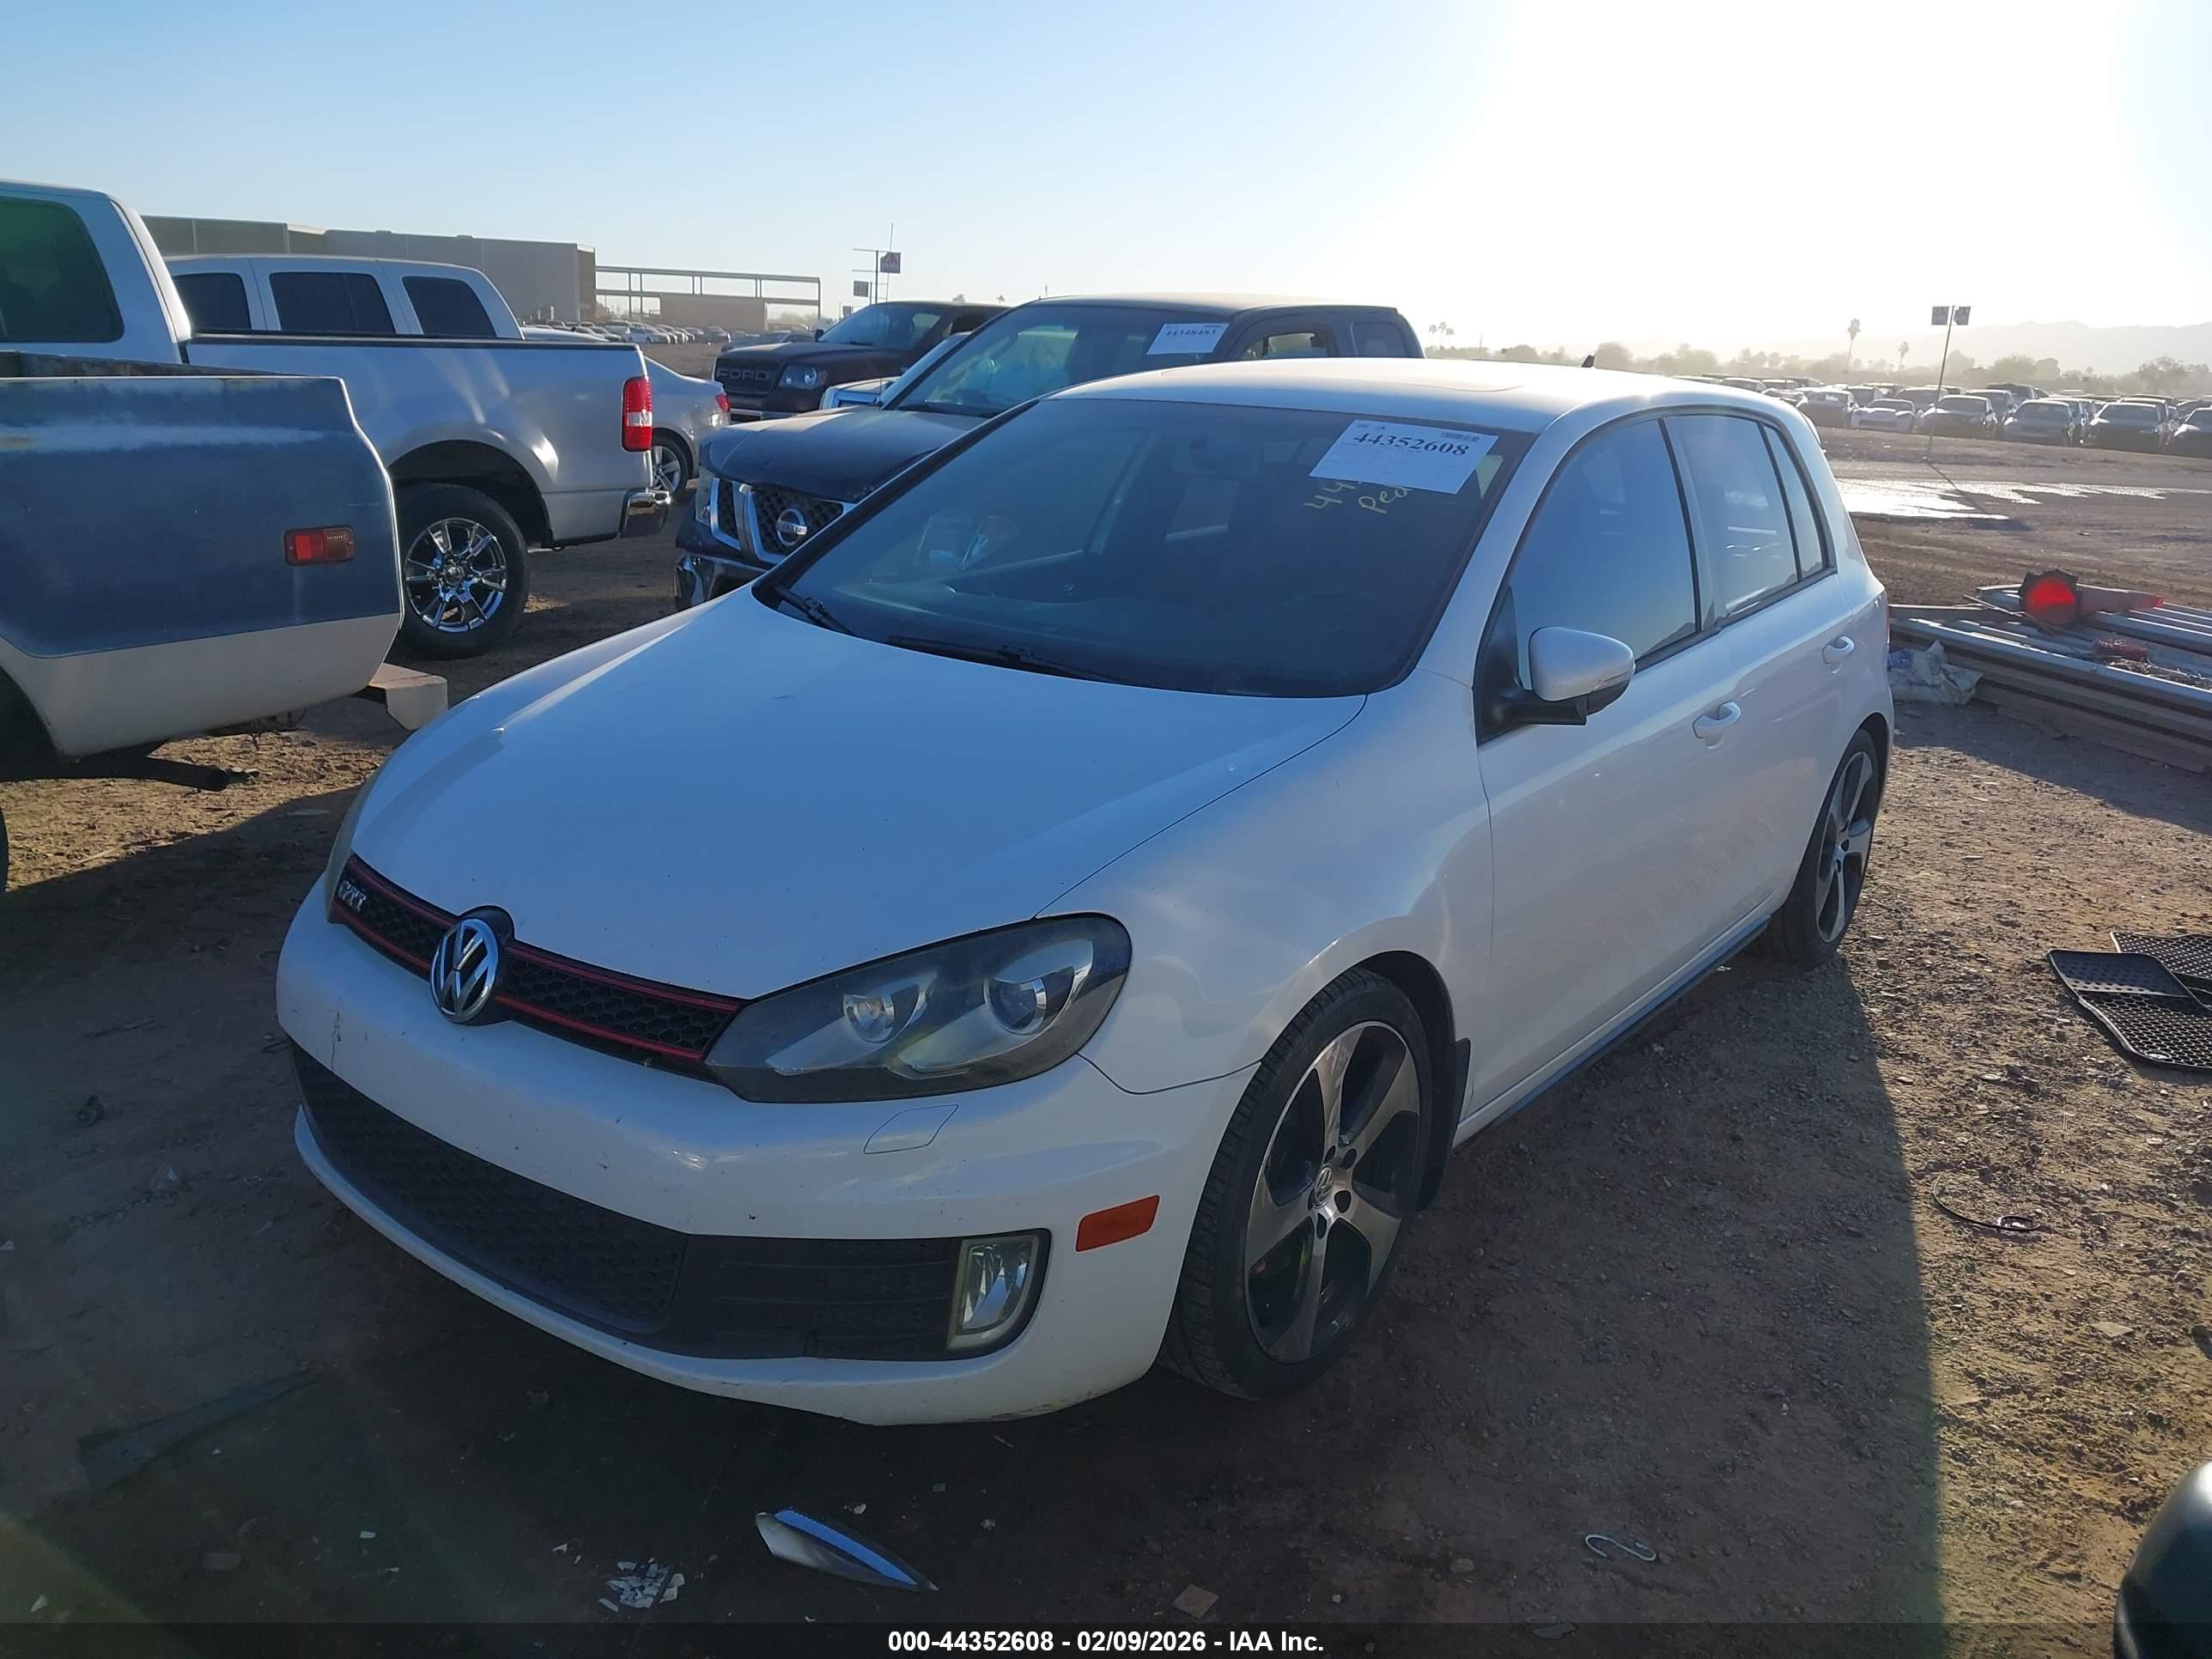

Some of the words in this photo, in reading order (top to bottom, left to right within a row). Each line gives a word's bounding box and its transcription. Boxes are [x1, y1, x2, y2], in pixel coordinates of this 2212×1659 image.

[716, 368, 769, 380] FORD
[1353, 433, 1469, 456] 44352608
[1303, 482, 1362, 509] 44
